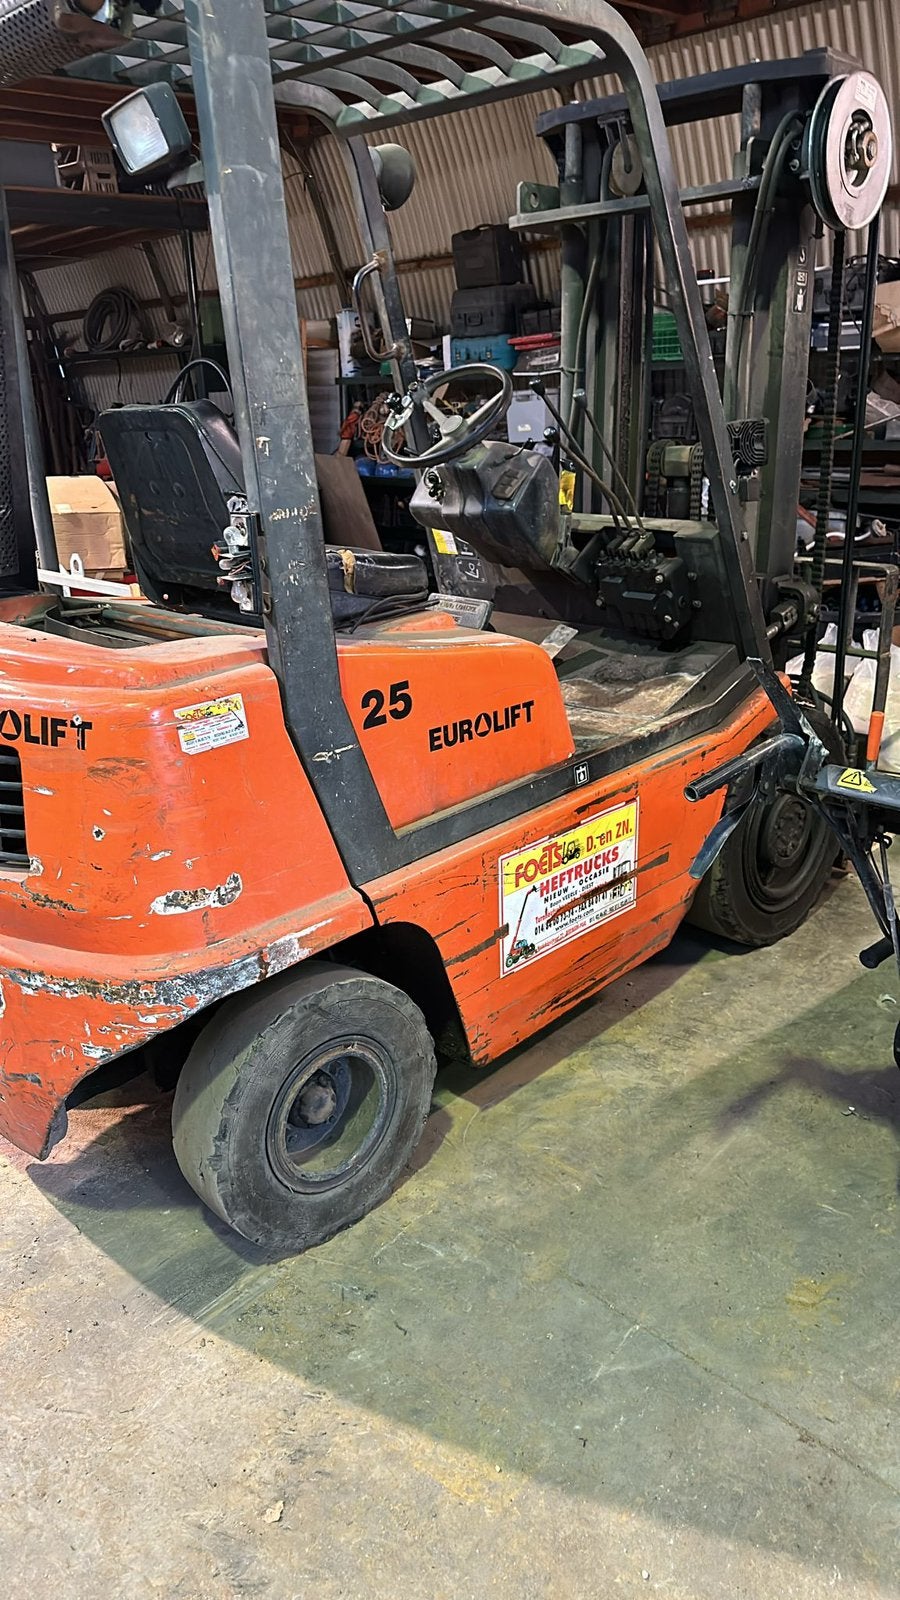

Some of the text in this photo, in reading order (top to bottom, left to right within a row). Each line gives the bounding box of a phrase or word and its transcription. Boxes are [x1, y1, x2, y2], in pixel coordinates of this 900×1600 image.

[361, 680, 413, 730] 25
[429, 699, 535, 752] EUROLIFT
[515, 819, 632, 888] FOETS D. en ZN.
[539, 846, 619, 898] HEFTRUCKS
[543, 886, 569, 904] NIEUW
[579, 866, 609, 886] OCCASIE
[555, 908, 594, 931] www.foets.com
